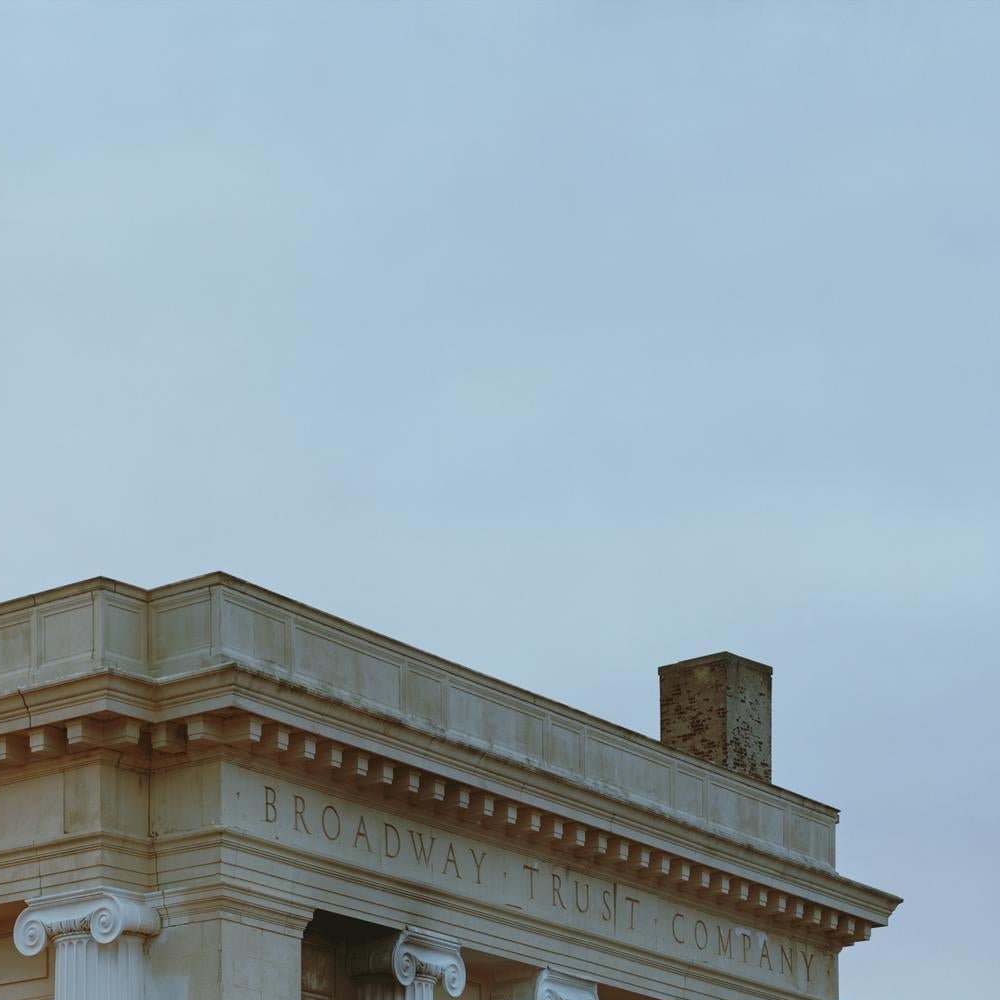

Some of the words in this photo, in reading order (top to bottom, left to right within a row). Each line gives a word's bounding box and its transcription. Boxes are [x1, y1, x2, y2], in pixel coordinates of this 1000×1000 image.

[264, 785, 486, 884] BROADWAY
[523, 864, 640, 930] TRUST
[672, 913, 814, 982] COMPANY
